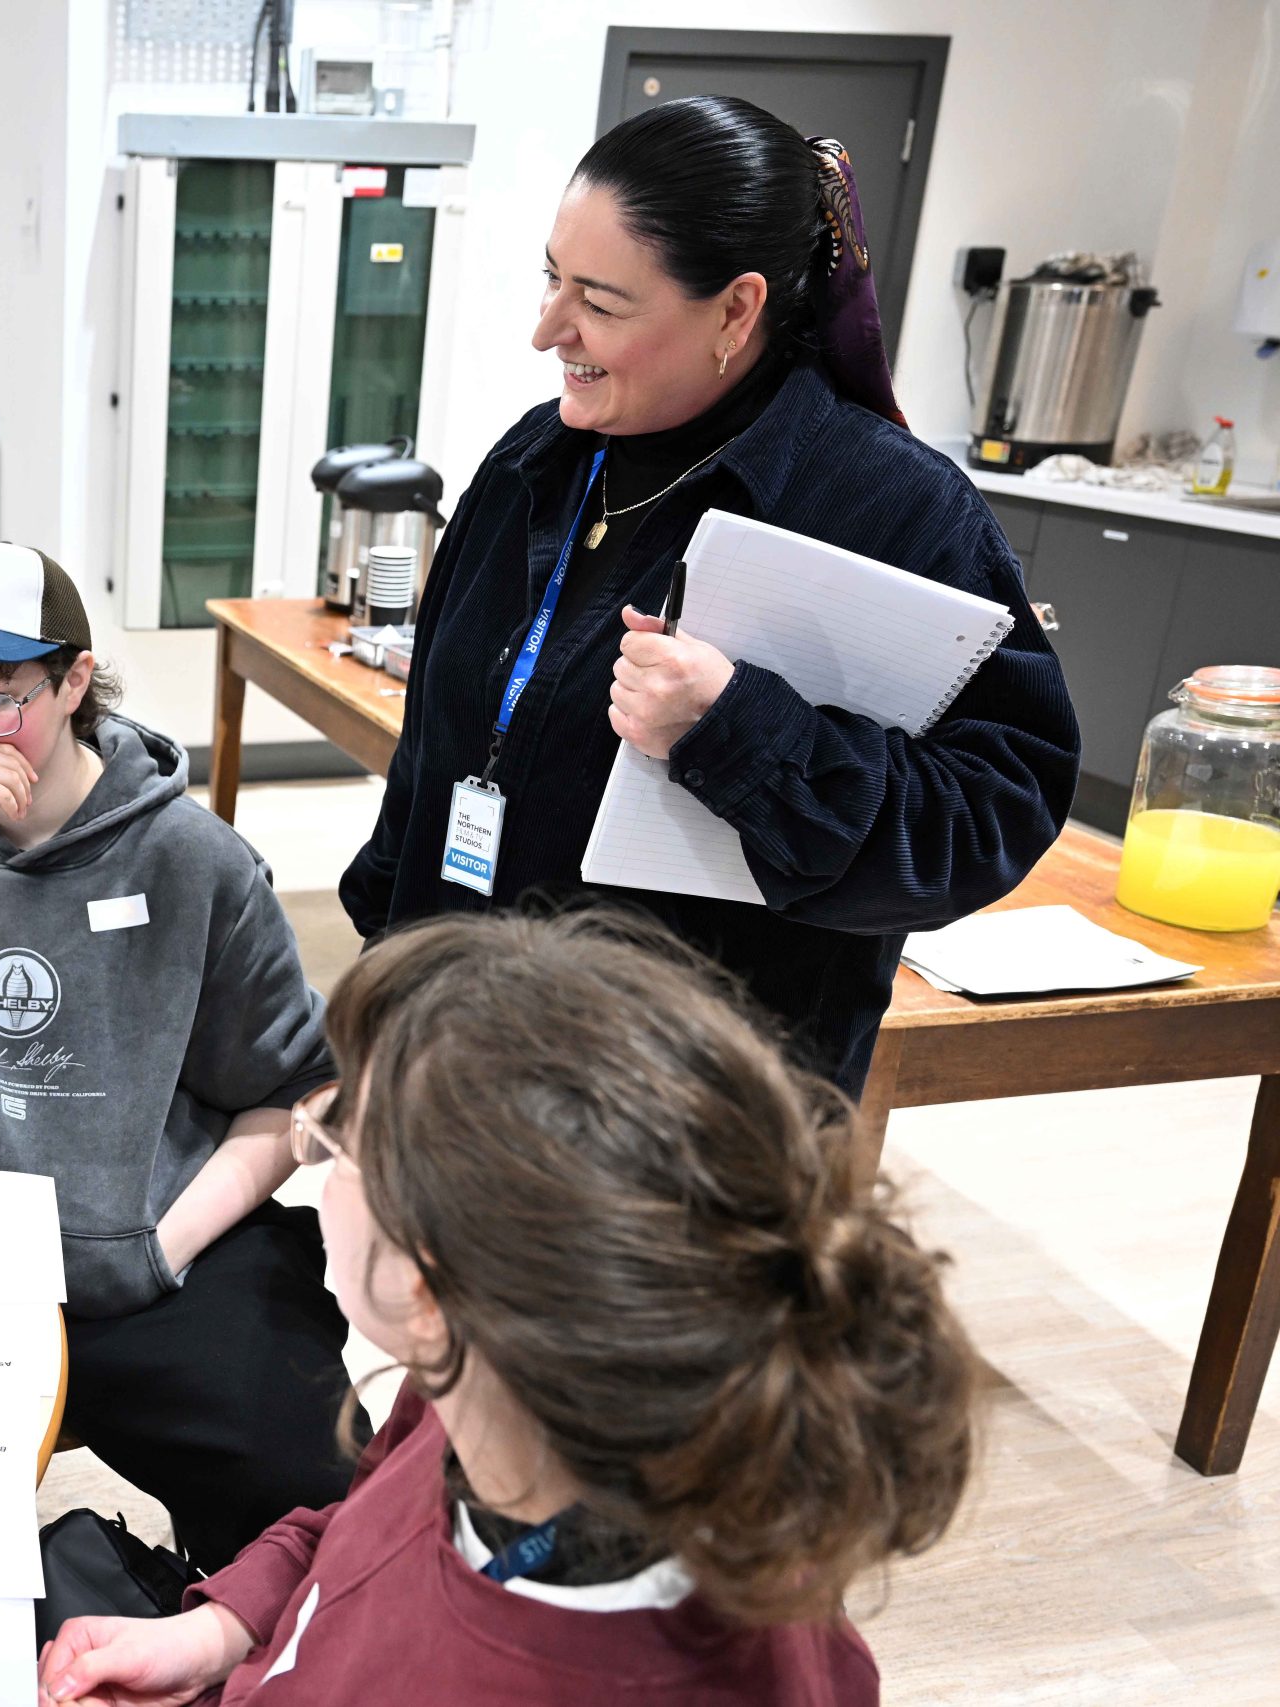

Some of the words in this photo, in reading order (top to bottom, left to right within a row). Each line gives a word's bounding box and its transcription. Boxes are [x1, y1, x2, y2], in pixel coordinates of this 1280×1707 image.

[554, 541, 574, 586] VISITOR
[525, 608, 551, 653] VISITOR
[458, 812, 471, 821] THE
[457, 819, 492, 836] NORTHERN
[455, 835, 482, 849] STUDIOS
[451, 852, 488, 873] VISITOR
